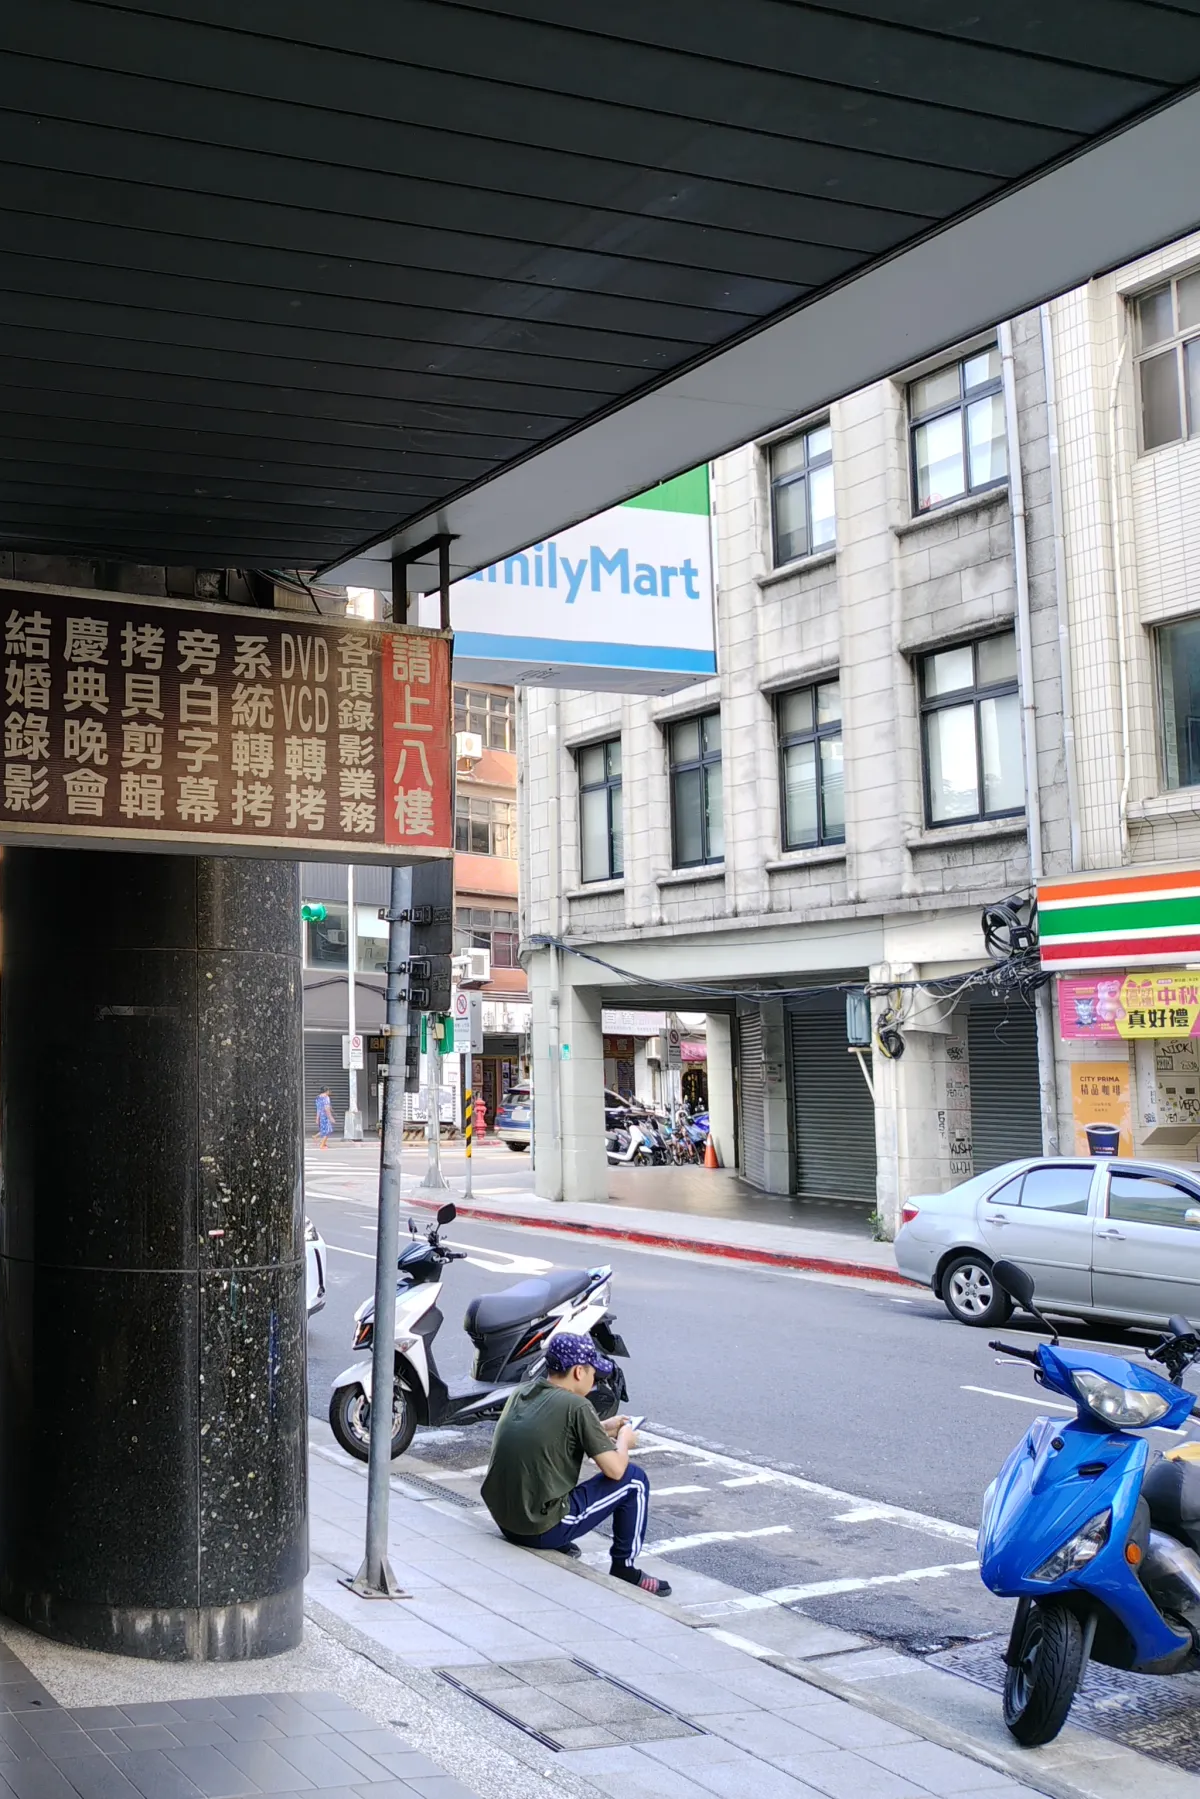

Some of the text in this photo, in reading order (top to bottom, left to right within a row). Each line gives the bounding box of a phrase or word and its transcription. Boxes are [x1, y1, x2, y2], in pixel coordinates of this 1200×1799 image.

[465, 542, 700, 604] milyMart
[3, 609, 52, 812] 結婚錄影
[63, 616, 110, 816] 慶典晚會
[119, 621, 166, 821] 拷貝剪輯
[176, 628, 221, 823] 旁白字幕
[280, 633, 329, 682] DVD
[280, 684, 329, 733] VCD
[231, 634, 275, 827] 系統轉拷
[284, 735, 327, 832] 轉拷
[337, 634, 377, 835] 各項錄影業務
[390, 636, 435, 838] 請上八樓
[1127, 1008, 1190, 1029] 真好禮
[1157, 986, 1200, 1006] 中秋
[1081, 1084, 1121, 1096] 精品咖啡
